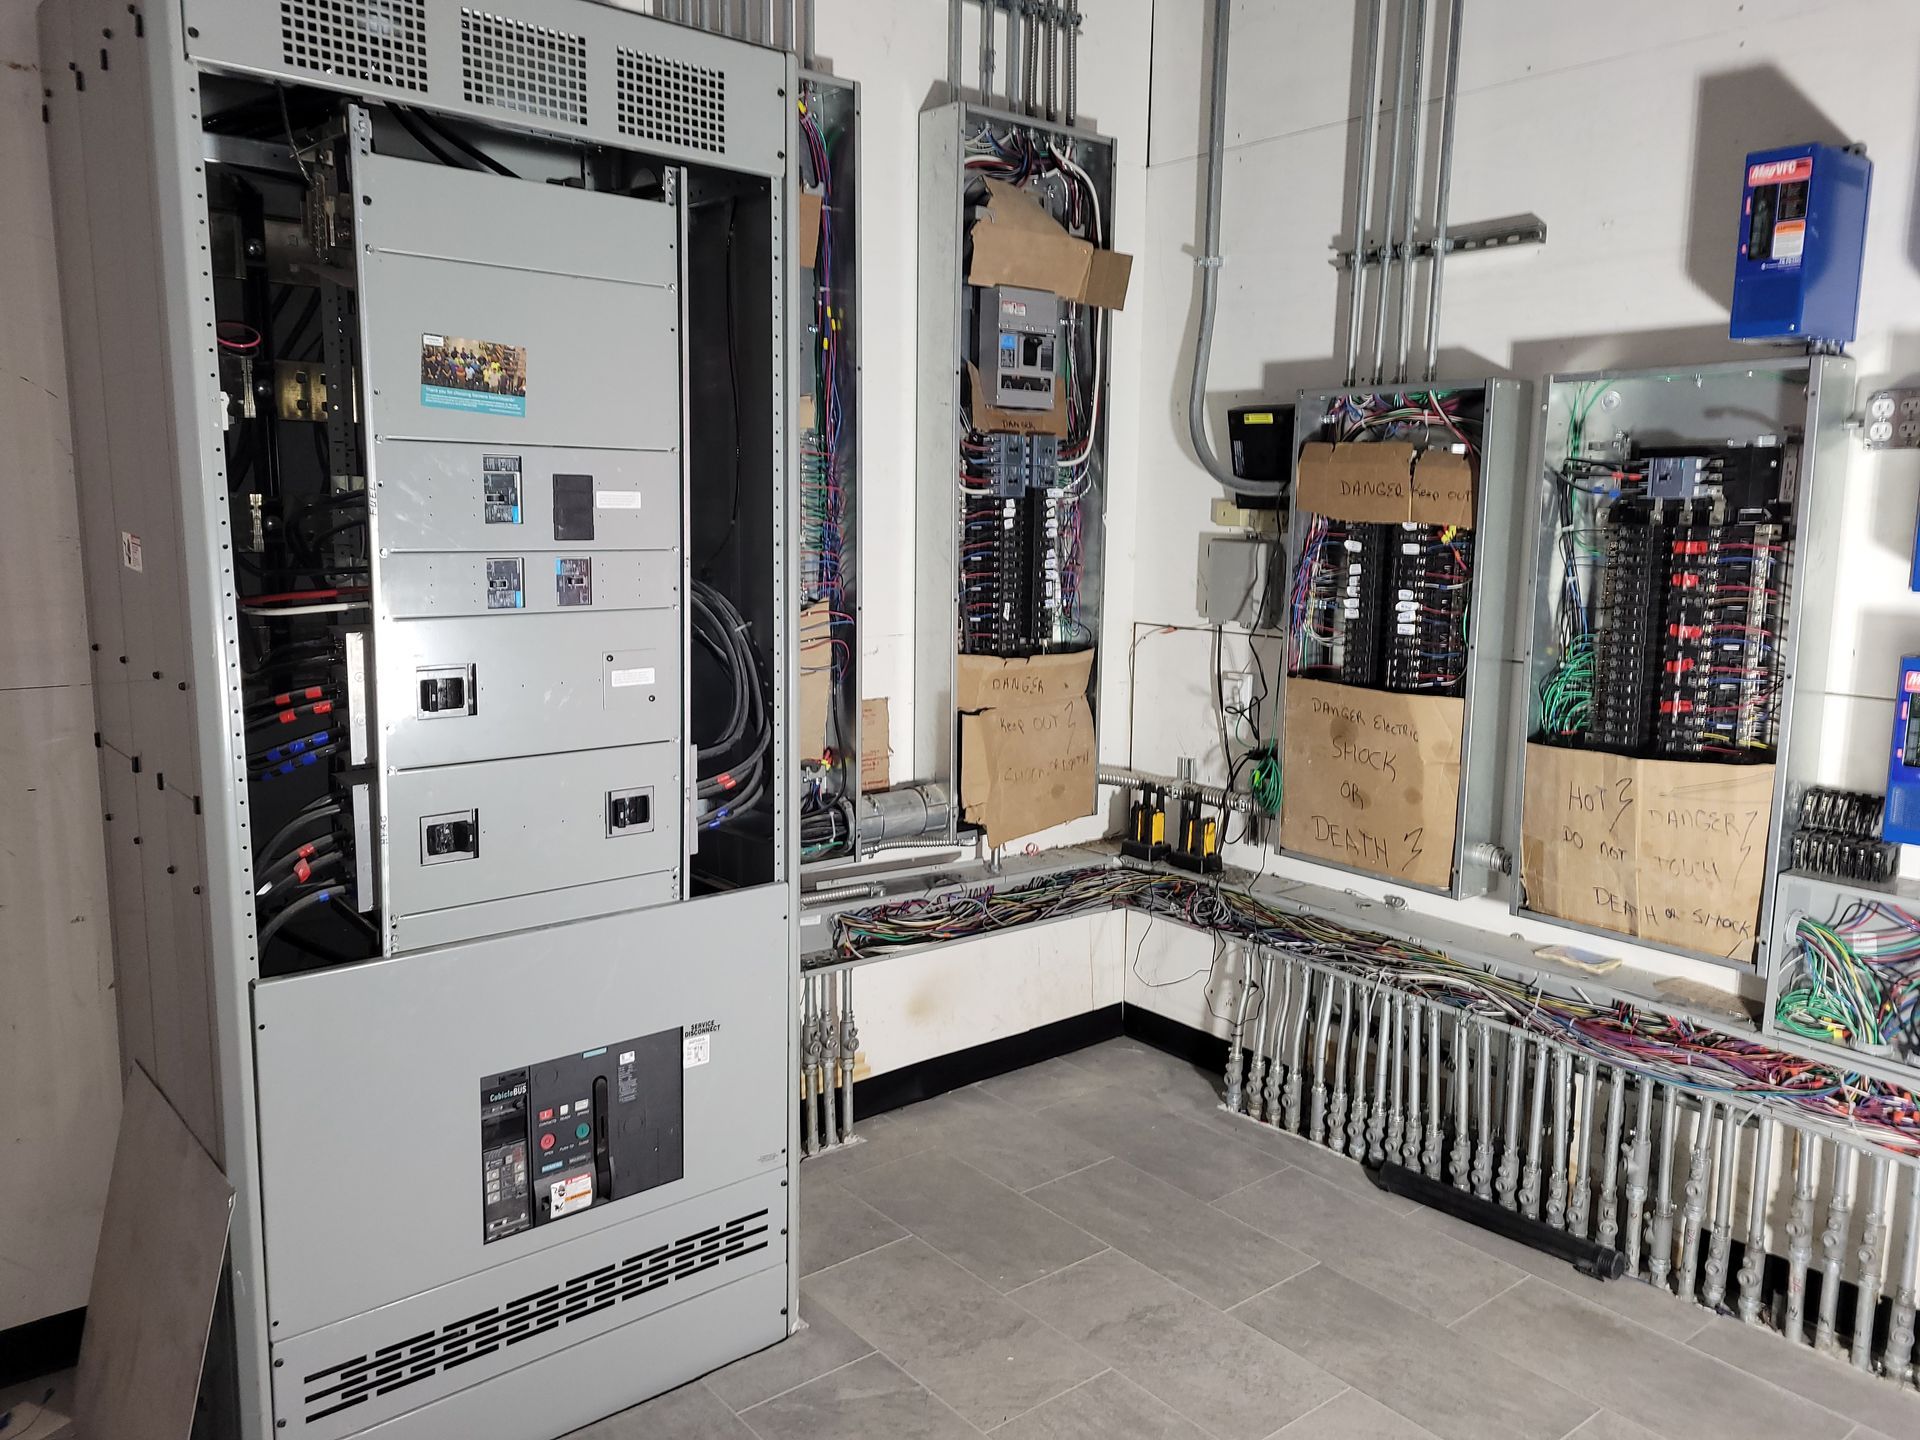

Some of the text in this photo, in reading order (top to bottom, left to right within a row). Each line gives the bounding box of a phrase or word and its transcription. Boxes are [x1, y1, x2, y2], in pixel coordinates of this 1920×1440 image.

[1340, 480, 1404, 498] DANGER
[992, 676, 1044, 695] DANGER
[1032, 714, 1058, 732] OUT
[1332, 735, 1397, 782] SHOCK
[1340, 780, 1364, 810] OR
[1311, 815, 1389, 868] DEATH
[1563, 825, 1584, 849] DO
[1652, 856, 1721, 883] TOUCH
[1592, 886, 1751, 939] DEATH OR SHOCK
[685, 1024, 721, 1038] DISCONNECT
[691, 1019, 715, 1030] SERVICE
